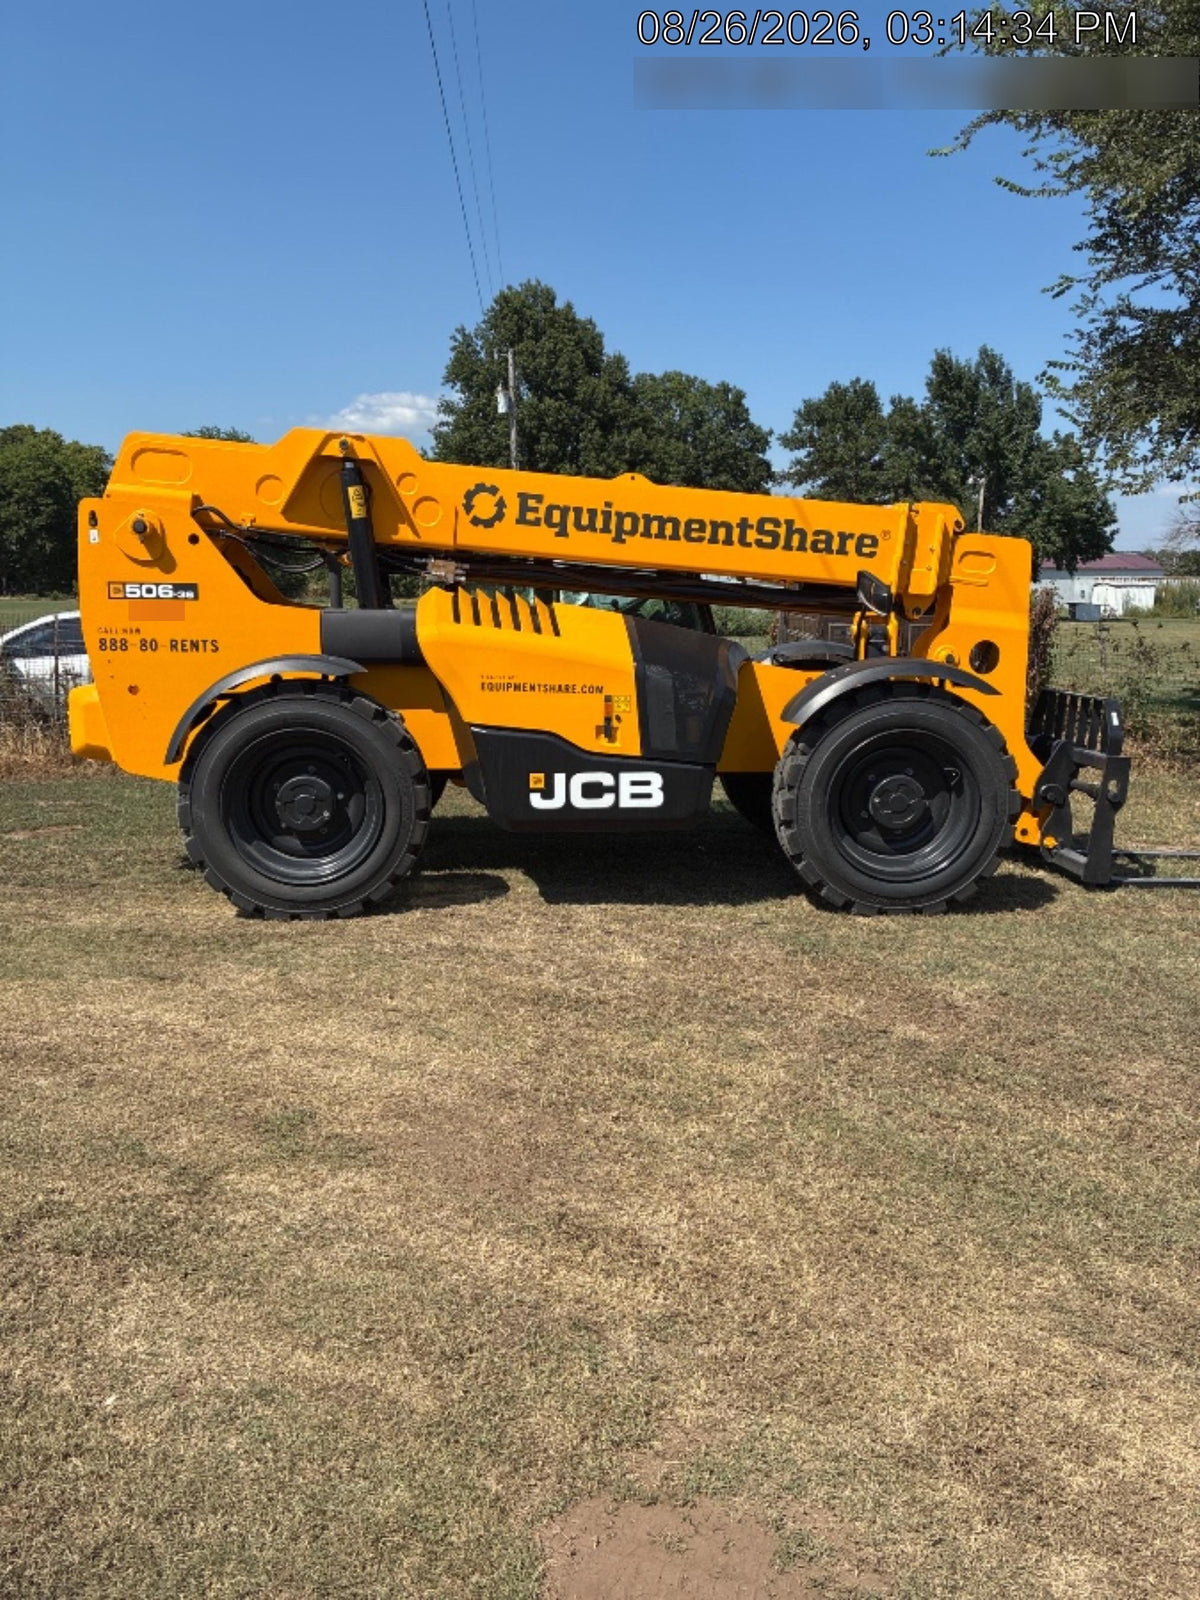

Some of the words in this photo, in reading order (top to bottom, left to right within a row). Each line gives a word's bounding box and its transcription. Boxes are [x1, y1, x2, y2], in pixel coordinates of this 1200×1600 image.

[515, 491, 879, 559] EquipmentShare
[480, 682, 604, 694] EQUIPMENTSHARE.COM
[529, 771, 664, 809] JCB
